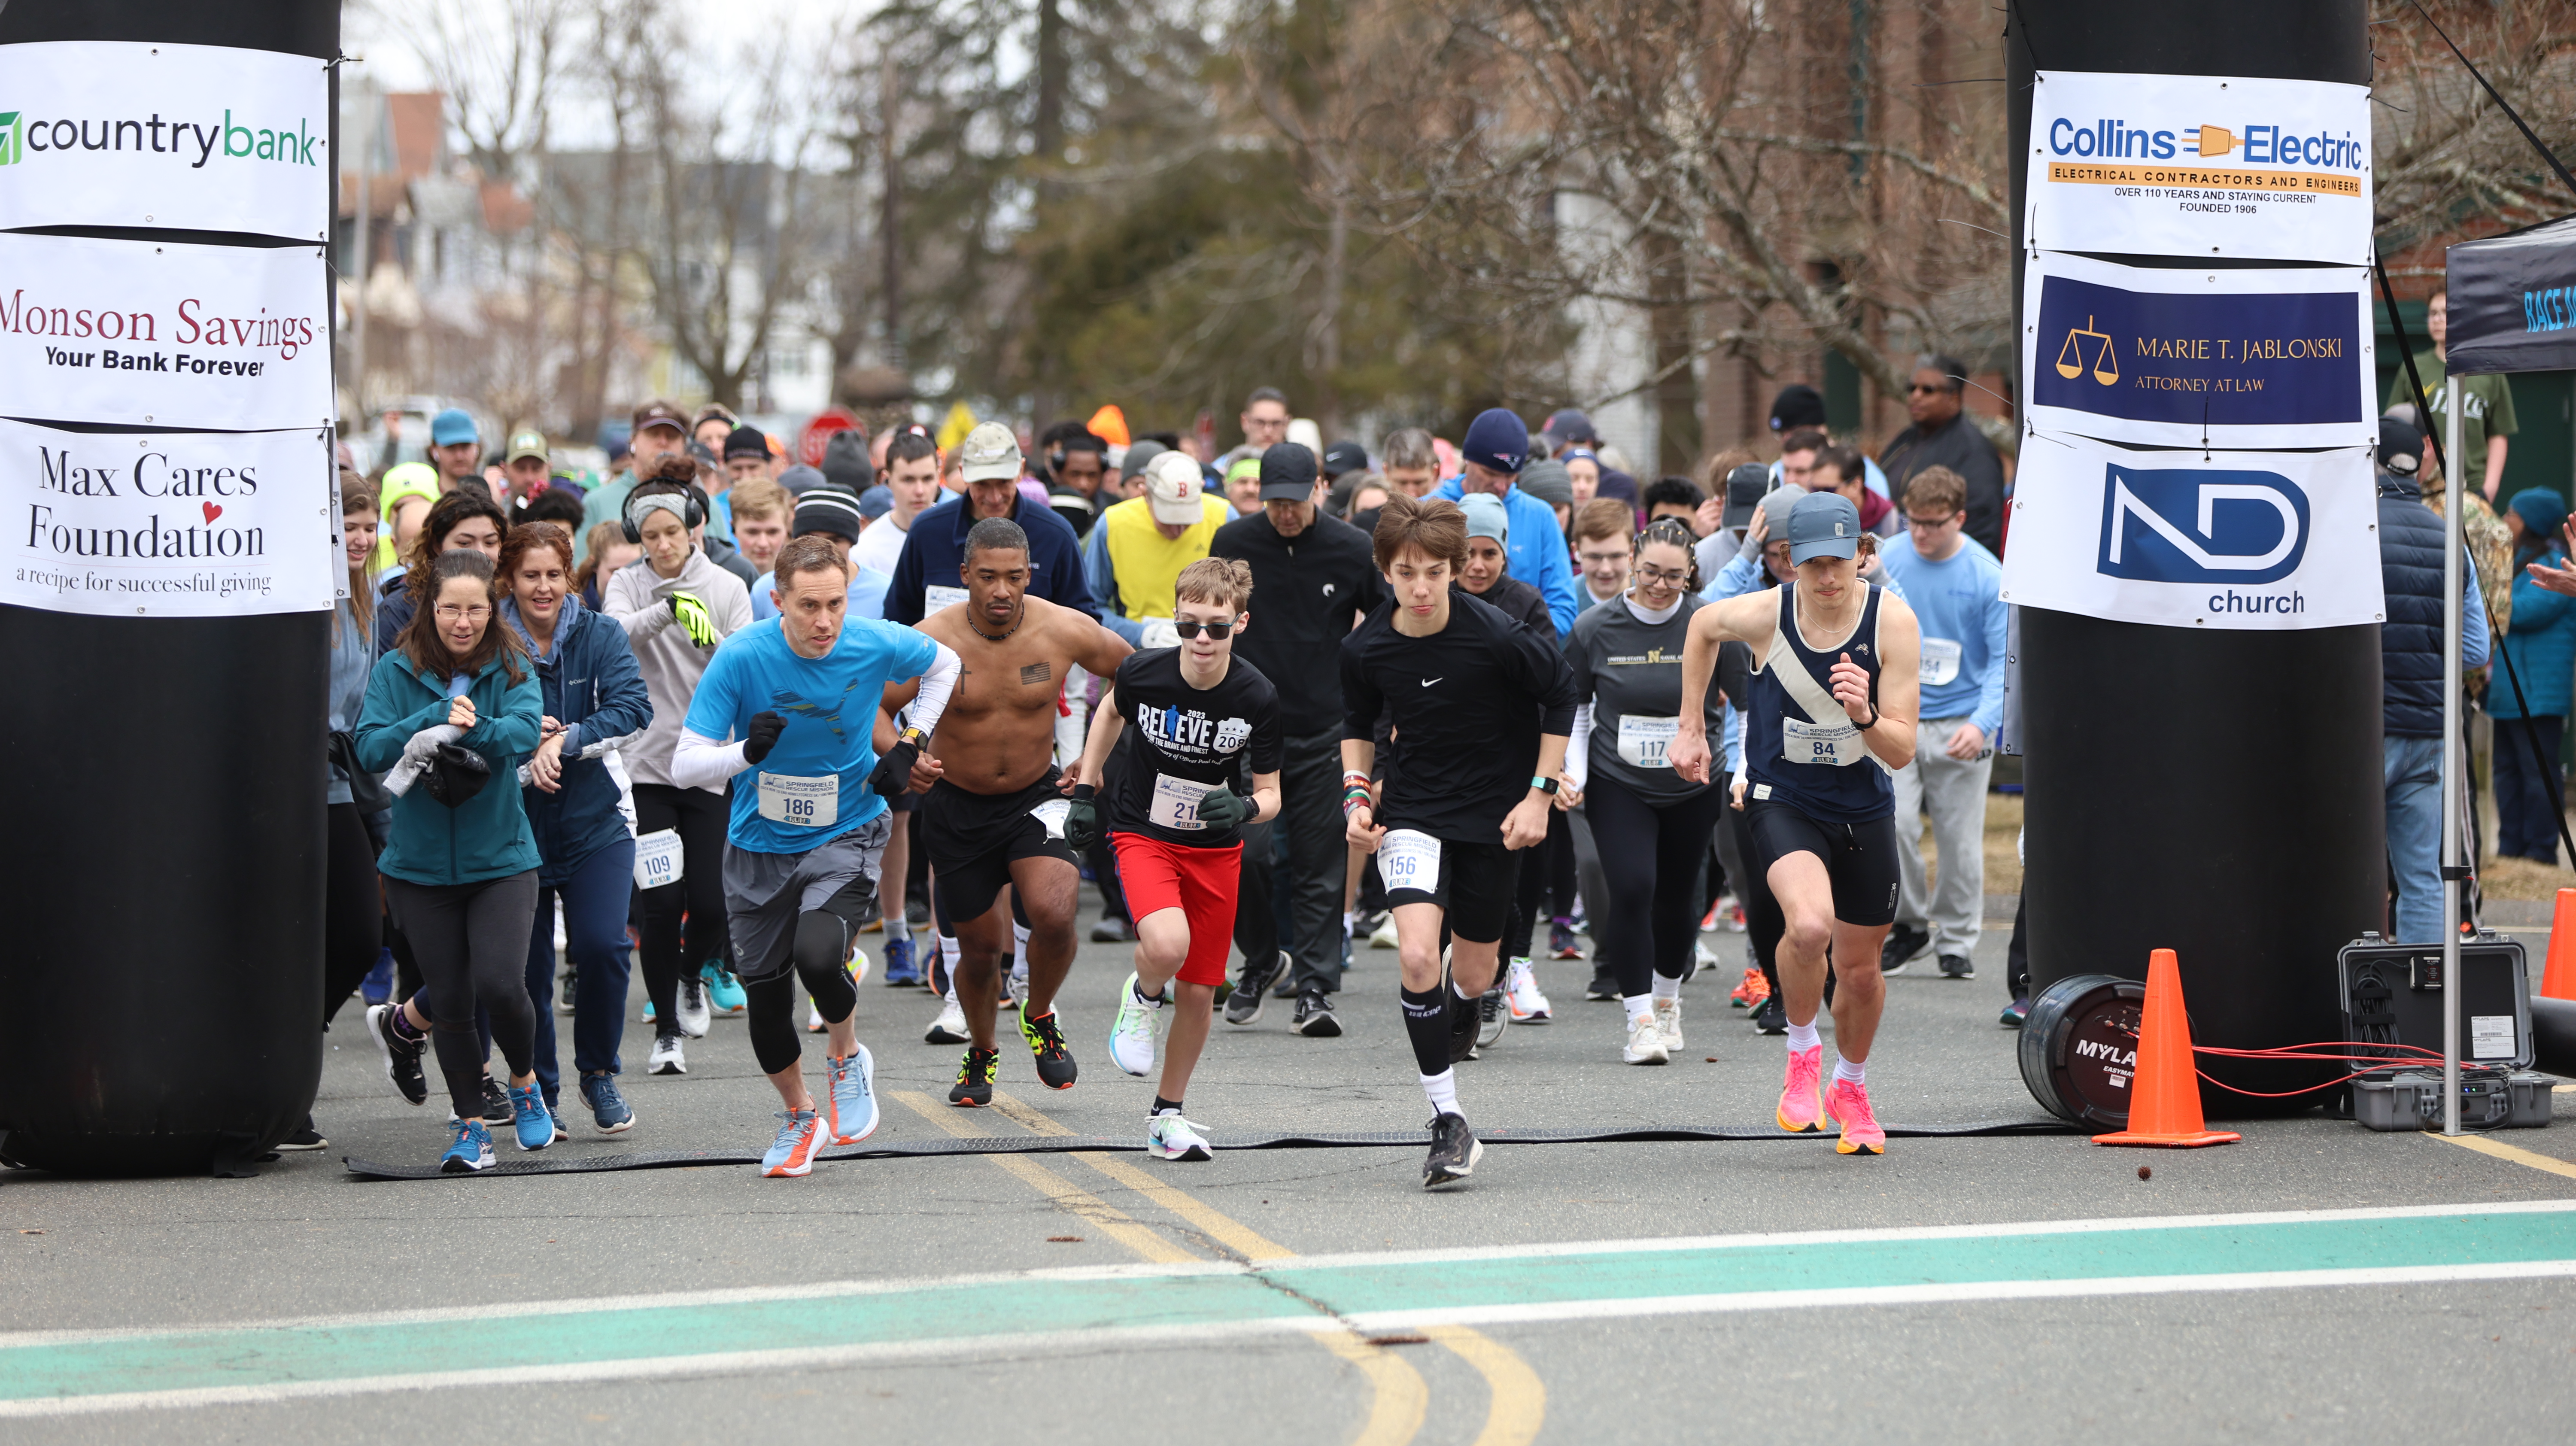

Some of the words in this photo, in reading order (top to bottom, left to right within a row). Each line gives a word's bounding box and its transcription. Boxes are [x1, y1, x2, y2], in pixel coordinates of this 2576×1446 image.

[27, 109, 317, 168] countrybank
[2050, 118, 2176, 159] Collins
[2244, 125, 2362, 170] Electric
[2055, 168, 2136, 181] ELECTRICAL
[2145, 172, 2263, 186] CONTRACTORS
[2270, 176, 2298, 187] AND
[2306, 177, 2359, 193] ENGINEERS
[2114, 188, 2142, 197] OVER
[2145, 188, 2161, 197] 110
[2164, 189, 2200, 199] YEARS
[2202, 190, 2225, 200] AND
[2228, 191, 2271, 202] STAYING
[2273, 193, 2317, 204] CURRENT
[2180, 203, 2231, 213] FOUNDED
[2234, 204, 2257, 214] 1906
[2524, 289, 2564, 333] RACE
[0, 289, 158, 342] Monson
[176, 298, 313, 361] Savings
[2137, 337, 2210, 359] MARIE
[2217, 340, 2234, 359] T.
[2241, 338, 2342, 364] JABLONSKI
[46, 346, 95, 367] Your
[103, 350, 168, 372] Bank
[176, 354, 264, 377] Forever
[2135, 376, 2210, 392] ATTORNEY
[2215, 379, 2232, 392] AT
[2236, 379, 2264, 392] LAW
[39, 445, 121, 497] Max
[134, 453, 258, 497] Cares
[26, 503, 265, 558] Foundation
[17, 567, 25, 581] a
[30, 568, 79, 594] recipe
[85, 571, 112, 592] for
[118, 573, 215, 593] successful
[221, 572, 272, 598] giving
[2209, 590, 2304, 614] church
[1187, 709, 1206, 719] 2023
[1835, 728, 1856, 737] MISSION
[1155, 737, 1164, 747] THE
[1164, 740, 1180, 750] BRAVE
[1191, 746, 1209, 755] FINEST
[1218, 736, 1245, 748] 208
[1640, 741, 1665, 756] 117
[1813, 741, 1835, 755] 84
[1179, 755, 1197, 763] Officer
[1182, 785, 1212, 795] SPRING
[784, 798, 814, 816] 186
[1174, 802, 1201, 821] 21
[784, 815, 811, 824] 4RUN3
[1174, 821, 1201, 829] 4RUN3
[1392, 836, 1437, 848] SPRINGFIELD
[1413, 842, 1436, 853] MISSION
[644, 855, 670, 875] 109
[1389, 857, 1416, 876] 156
[2076, 1039, 2136, 1067] MYLA
[2103, 1066, 2135, 1078] EASYMAT
